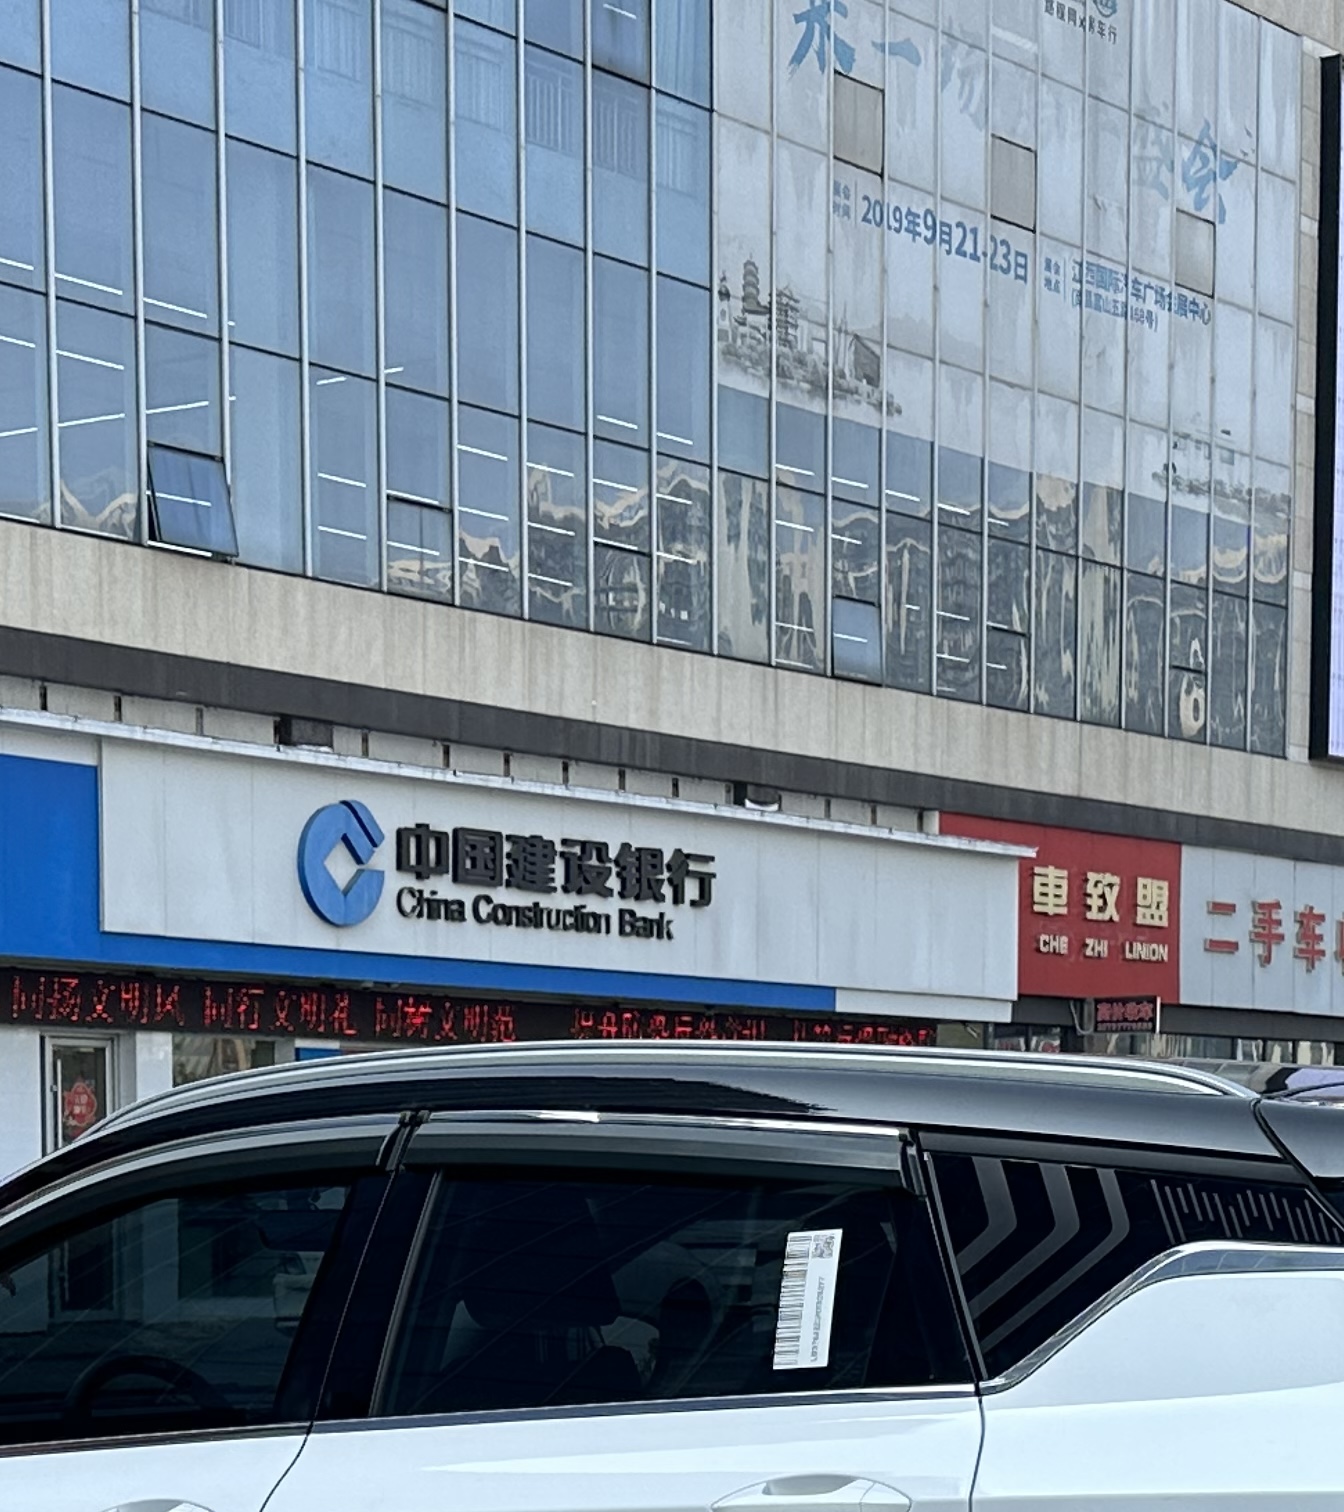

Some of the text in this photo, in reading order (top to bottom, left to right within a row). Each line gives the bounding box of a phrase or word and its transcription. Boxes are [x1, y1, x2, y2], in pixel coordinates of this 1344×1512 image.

[396, 823, 717, 908] 中国建设银行
[397, 886, 674, 940] China Construction Bank
[1030, 864, 1170, 928] 車致盟
[1038, 933, 1069, 955] CHE
[1084, 937, 1108, 958] ZHI
